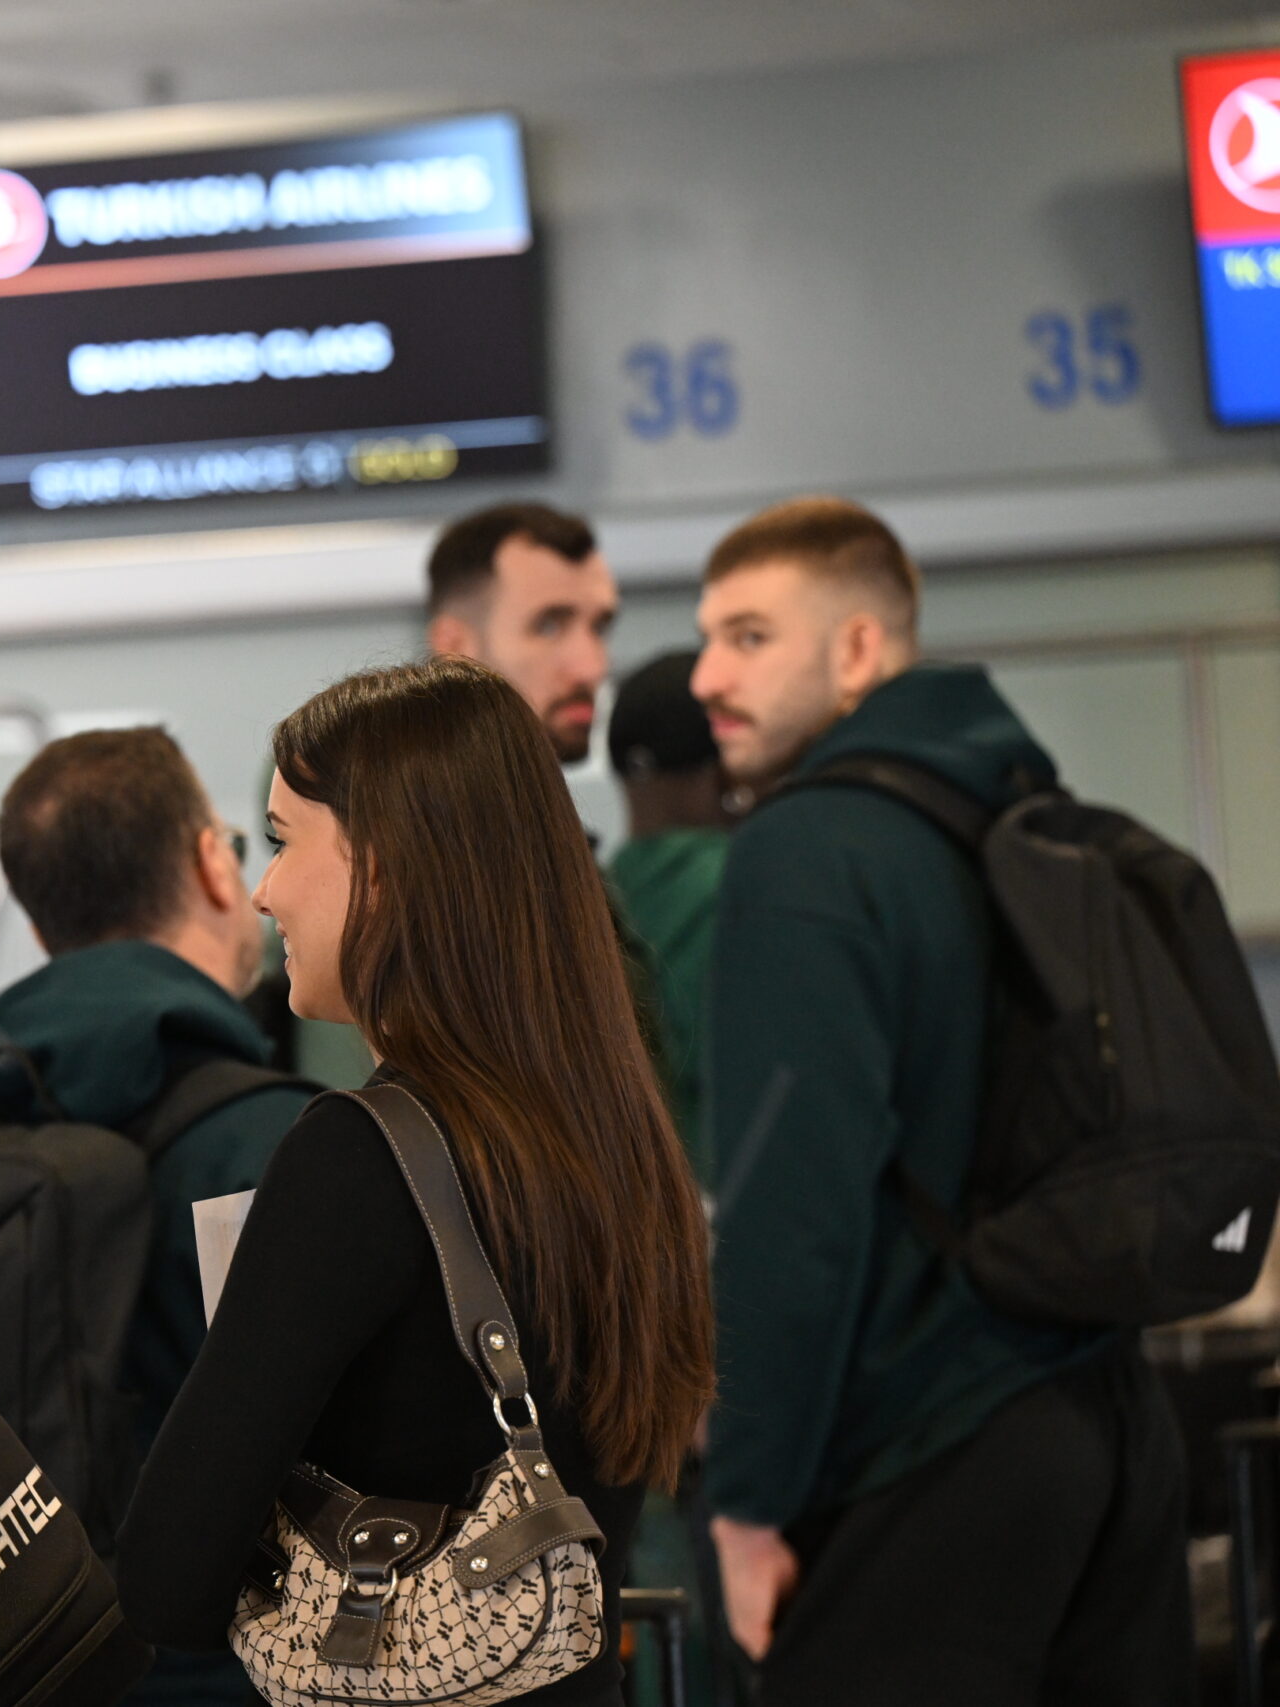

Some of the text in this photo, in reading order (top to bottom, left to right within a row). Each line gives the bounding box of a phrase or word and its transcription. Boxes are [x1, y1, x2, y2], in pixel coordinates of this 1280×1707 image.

[47, 154, 493, 247] TURKISH AIRLINES
[69, 321, 393, 395] BUSINESS CLASS
[623, 337, 740, 441] 36
[1025, 303, 1142, 412] 35
